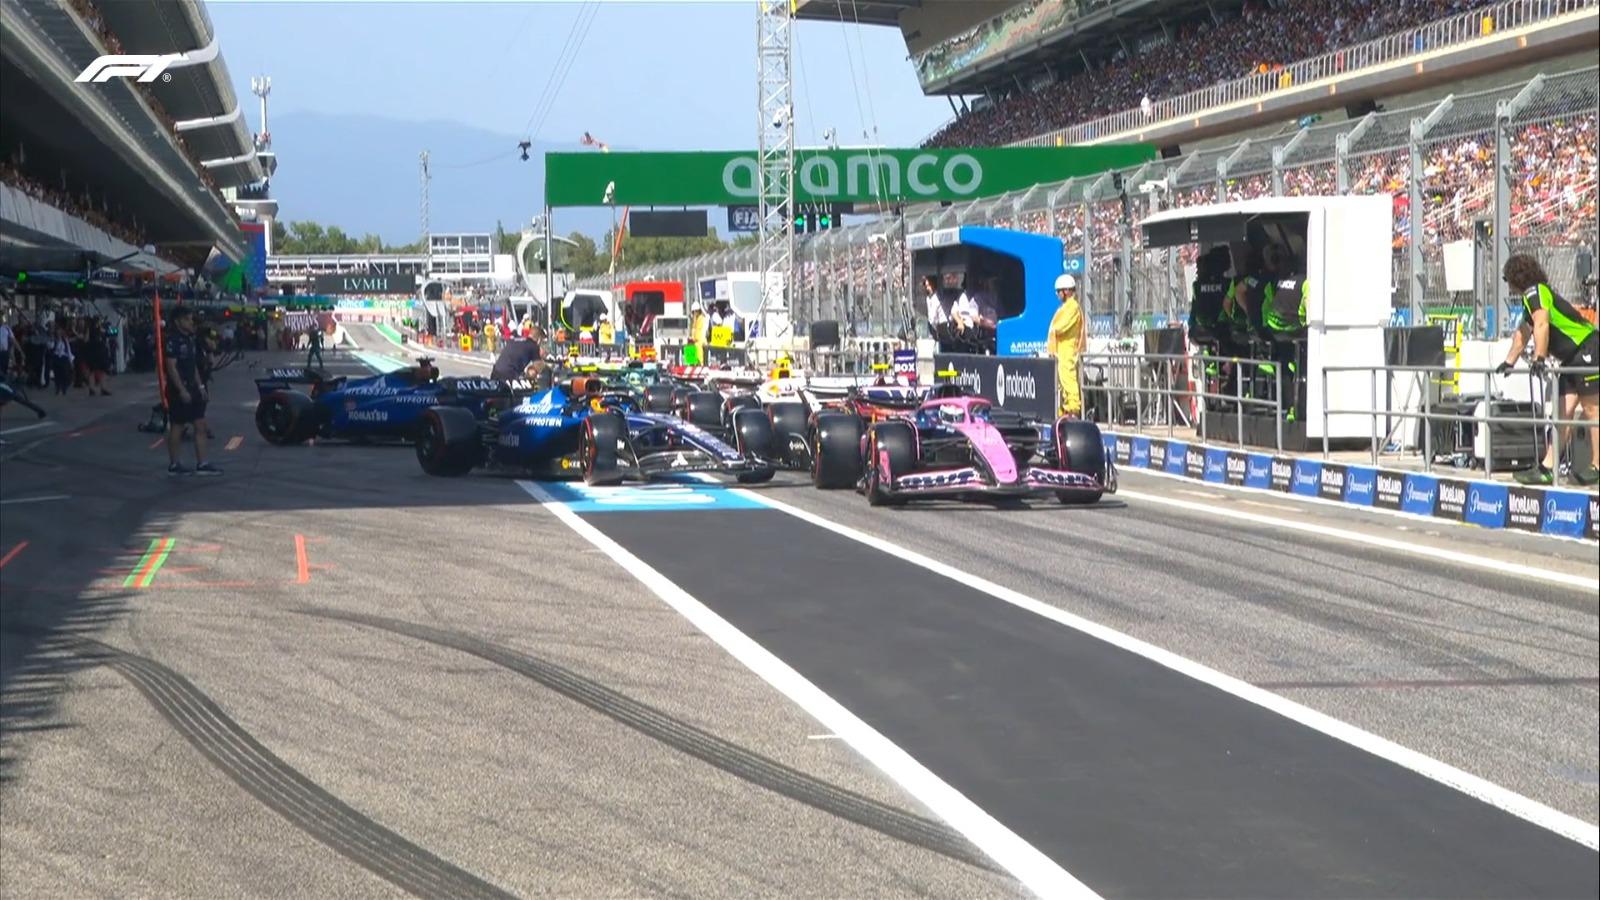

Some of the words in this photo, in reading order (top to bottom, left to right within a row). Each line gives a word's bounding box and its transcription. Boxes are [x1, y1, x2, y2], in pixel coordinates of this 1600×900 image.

[722, 154, 983, 197] aramco
[735, 210, 760, 225] FIA
[343, 278, 387, 290] LVMH
[895, 362, 914, 372] BOX
[1006, 370, 1036, 399] motorola
[348, 408, 388, 421] KOMATSU
[1509, 493, 1540, 514] MOBLAND
